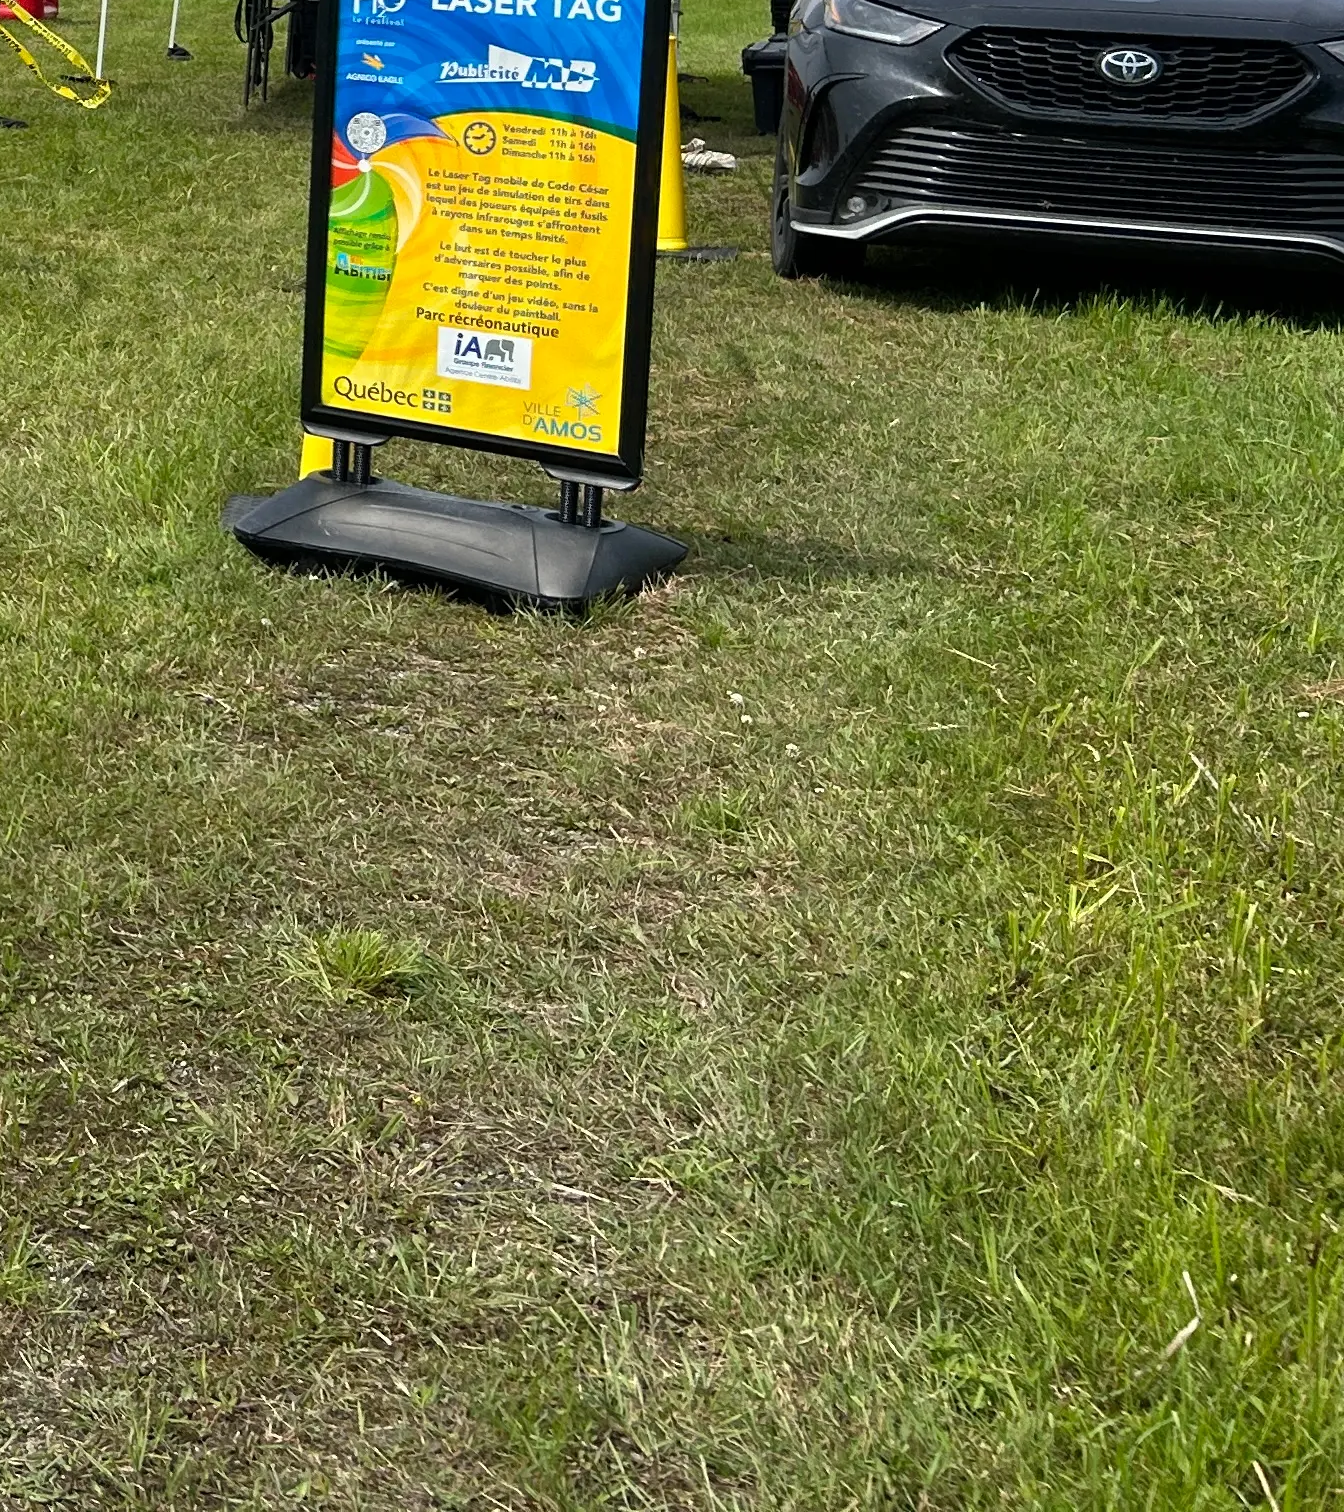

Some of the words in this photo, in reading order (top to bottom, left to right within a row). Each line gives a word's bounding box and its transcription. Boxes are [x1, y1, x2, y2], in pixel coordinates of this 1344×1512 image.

[440, 60, 520, 81] Publicité
[521, 57, 600, 93] MB
[502, 124, 546, 136] Vendredi
[550, 127, 568, 137] 11h
[579, 129, 597, 140] 16h
[502, 135, 537, 147] Samedi
[549, 139, 567, 149] 11h
[578, 141, 597, 152] 16h
[501, 147, 547, 160] Dimanche
[548, 151, 566, 161] 11h
[577, 154, 596, 164] 16h
[428, 168, 440, 177] Le
[442, 169, 469, 180] Laser
[473, 172, 491, 185] Tag
[494, 176, 528, 187] mobile
[532, 179, 544, 189] de
[548, 180, 575, 192] Code
[579, 183, 609, 195] César
[426, 182, 441, 190] est
[444, 183, 456, 191] un
[458, 185, 474, 195] jeu
[477, 186, 489, 195] de
[492, 187, 544, 202] simulation
[547, 193, 561, 204] de
[564, 196, 582, 206] tirs
[585, 198, 610, 209] dans
[426, 193, 456, 205] lequel
[459, 197, 477, 207] des
[479, 199, 517, 211] joueurs
[520, 204, 561, 217] équipés
[564, 208, 577, 219] de
[580, 210, 608, 221] fusils
[432, 206, 438, 216] à
[440, 210, 474, 220] rayons
[476, 212, 534, 228] infrarouges
[459, 223, 483, 234] dans
[485, 227, 498, 235] un
[501, 228, 533, 241] temps
[434, 254, 501, 270] d'adversaires
[504, 263, 549, 277] possible,
[553, 268, 573, 279] afin
[576, 270, 590, 281] de
[440, 241, 451, 251] Le
[454, 243, 472, 253] but
[474, 246, 490, 255] est
[493, 247, 505, 257] de
[509, 249, 549, 263] toucher
[552, 254, 561, 264] le
[564, 256, 587, 268] plus
[458, 271, 502, 285] marquer
[504, 275, 523, 286] des
[525, 279, 562, 291] points.
[423, 282, 449, 294] C'est
[451, 285, 480, 299] digne
[482, 290, 505, 301] d'un
[507, 293, 524, 304] jeu
[562, 303, 586, 313] sans
[589, 303, 598, 313] la
[454, 299, 494, 313] douleur
[497, 304, 510, 315] du
[513, 308, 561, 322] paintball.
[416, 307, 446, 323] Parc
[449, 312, 560, 338] récréonautique
[453, 357, 480, 369] Groupe
[333, 375, 419, 408] Québec
[523, 400, 562, 418] VILLE
[522, 414, 602, 442] D'AMOS
